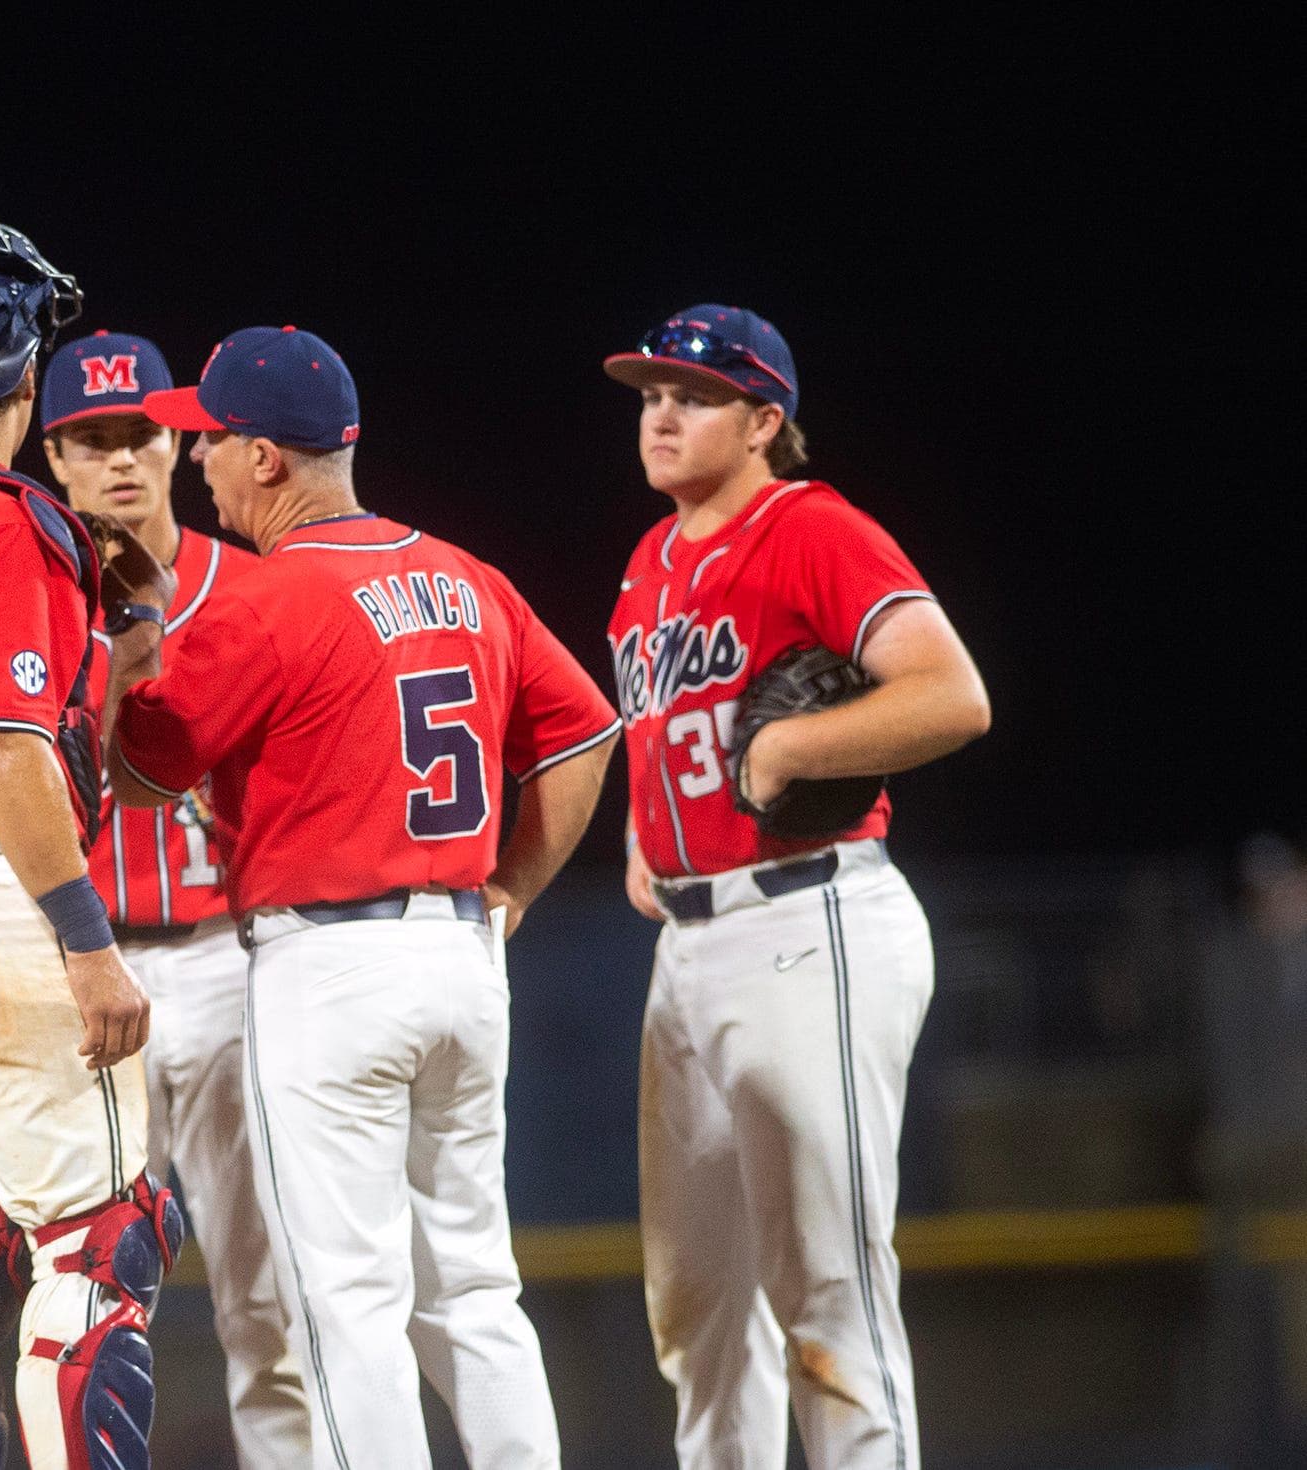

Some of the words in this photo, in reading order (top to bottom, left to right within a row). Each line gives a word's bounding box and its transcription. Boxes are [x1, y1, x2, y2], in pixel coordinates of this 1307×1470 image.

[80, 353, 141, 397] M
[352, 571, 482, 645] BIANCO
[11, 652, 46, 695] SEC
[395, 664, 491, 841] 5
